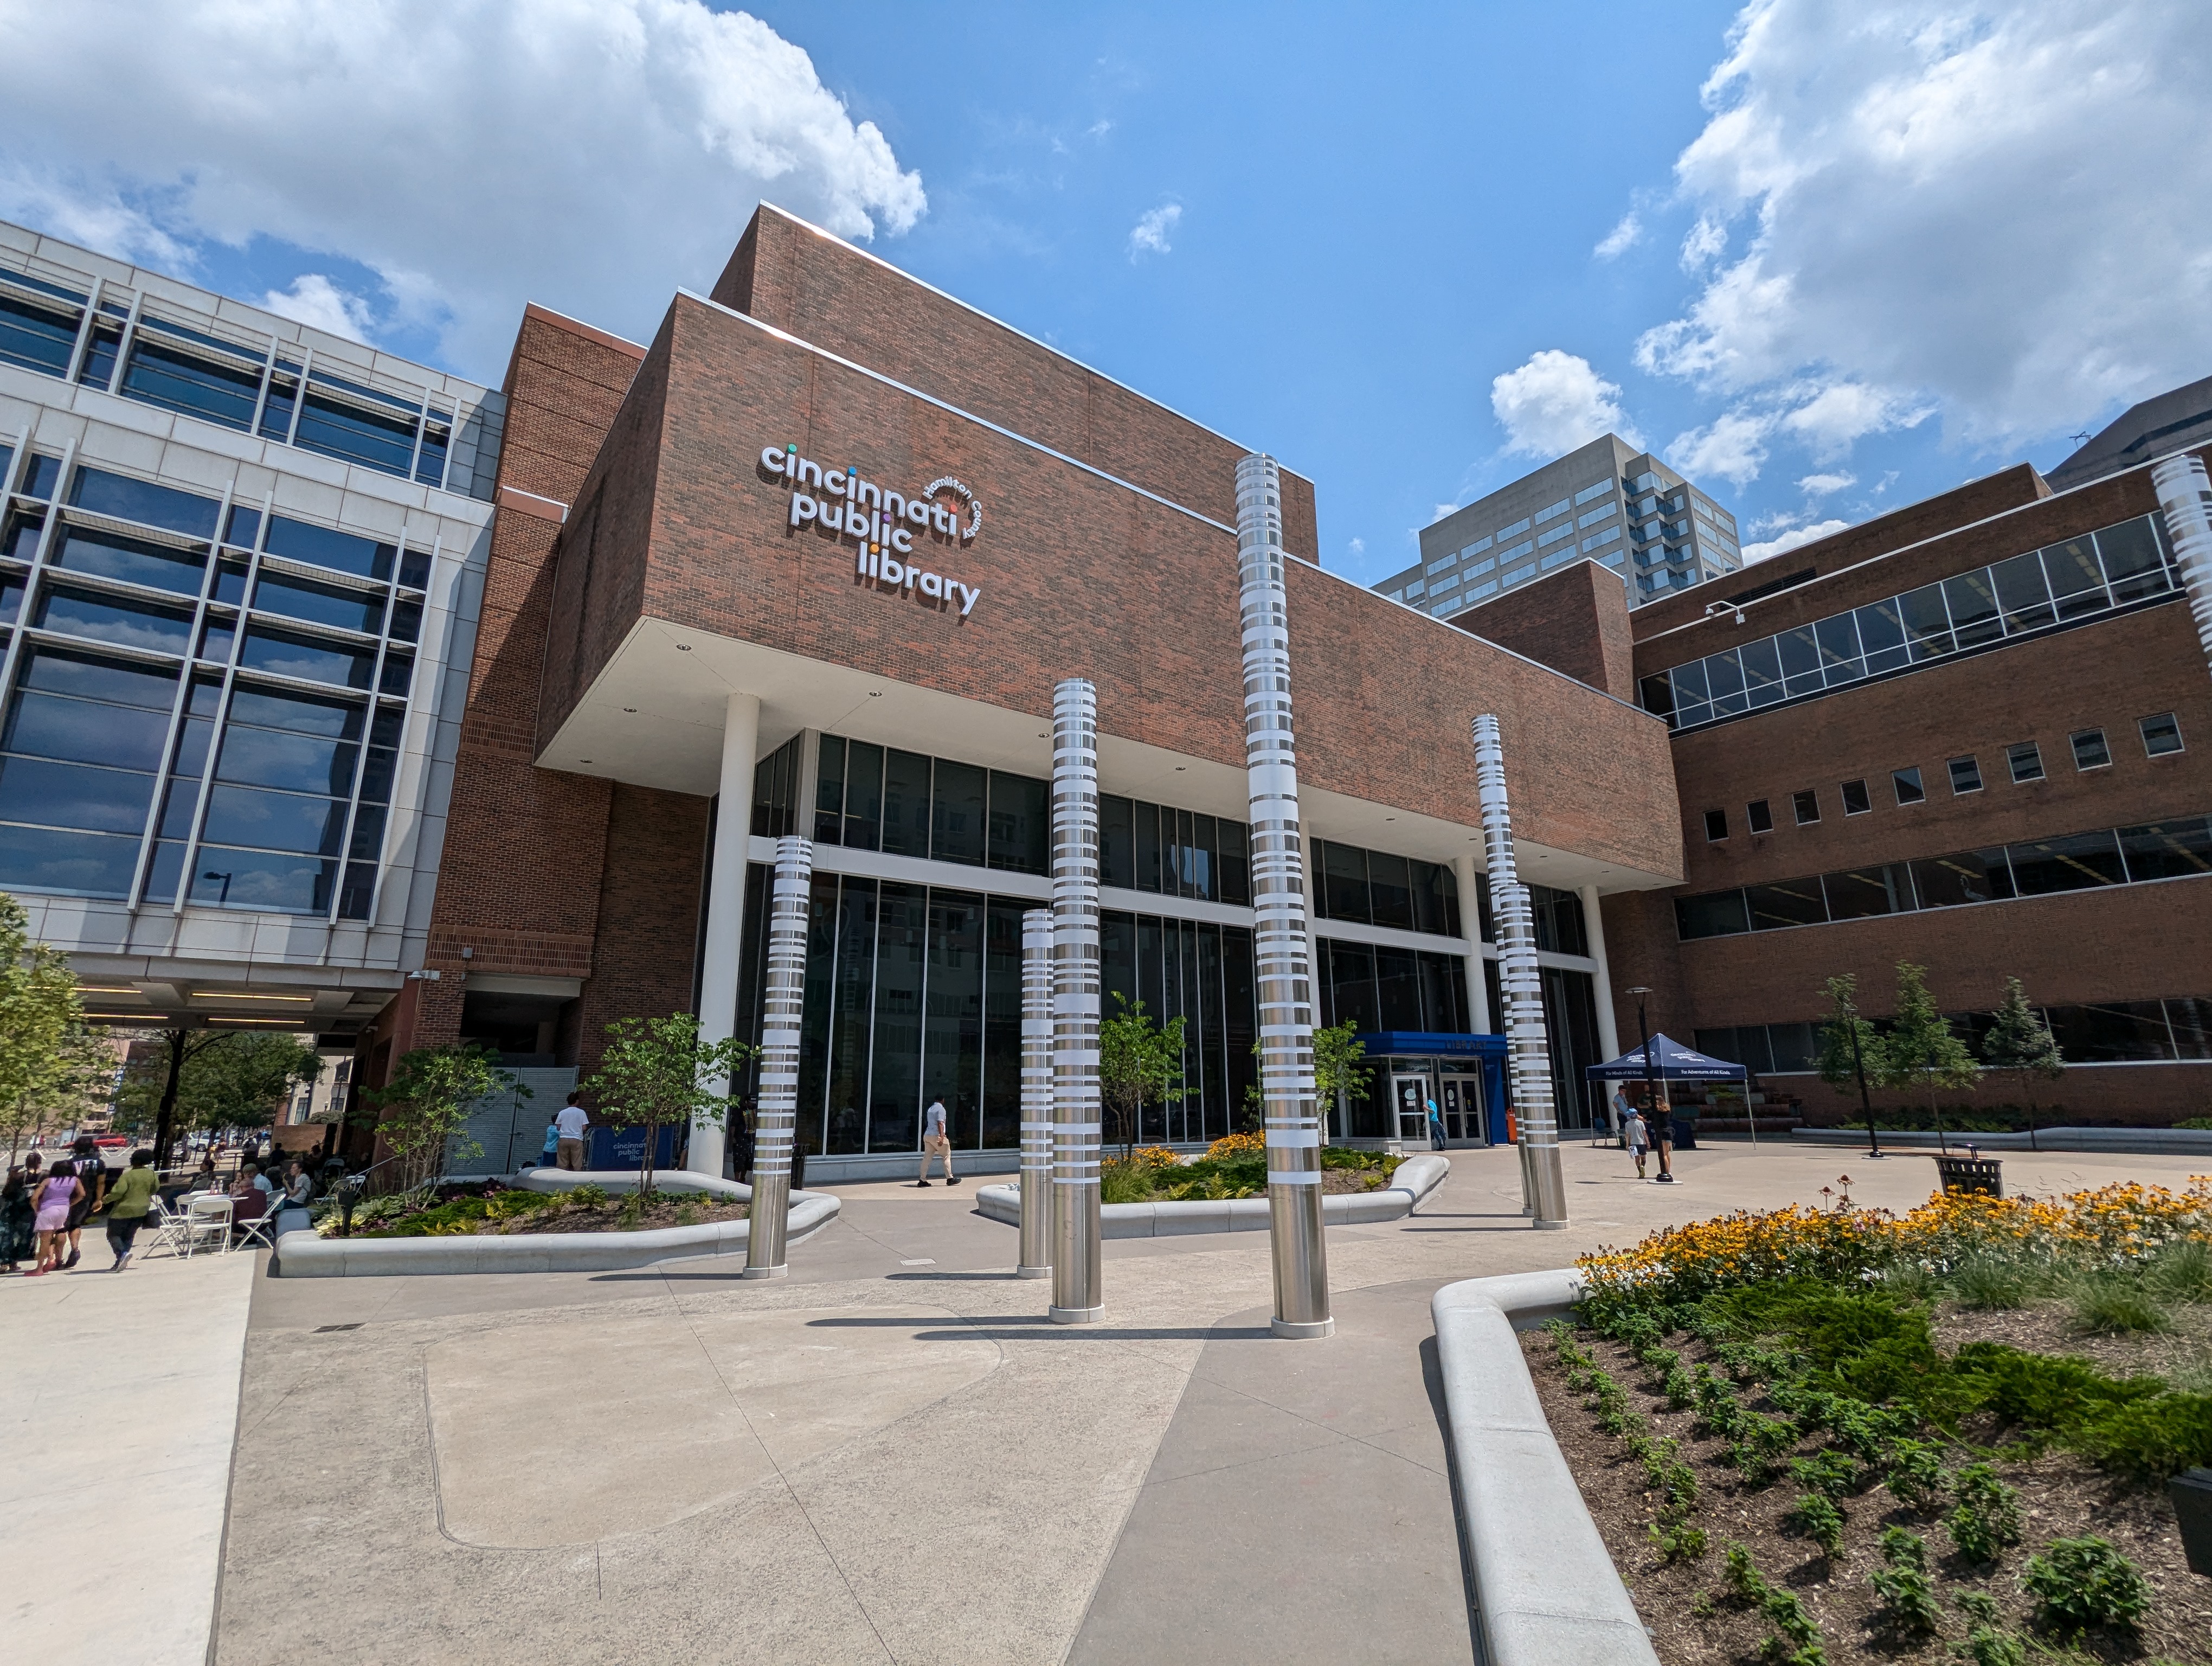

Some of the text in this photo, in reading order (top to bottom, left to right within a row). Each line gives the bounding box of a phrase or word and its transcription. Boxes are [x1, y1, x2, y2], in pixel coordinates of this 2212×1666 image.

[761, 443, 957, 536] cincinnati
[922, 476, 982, 540] Hamilton County
[790, 491, 913, 553] public
[858, 541, 981, 616] library
[1446, 1040, 1487, 1050] LIBRARY
[618, 1148, 640, 1157] public
